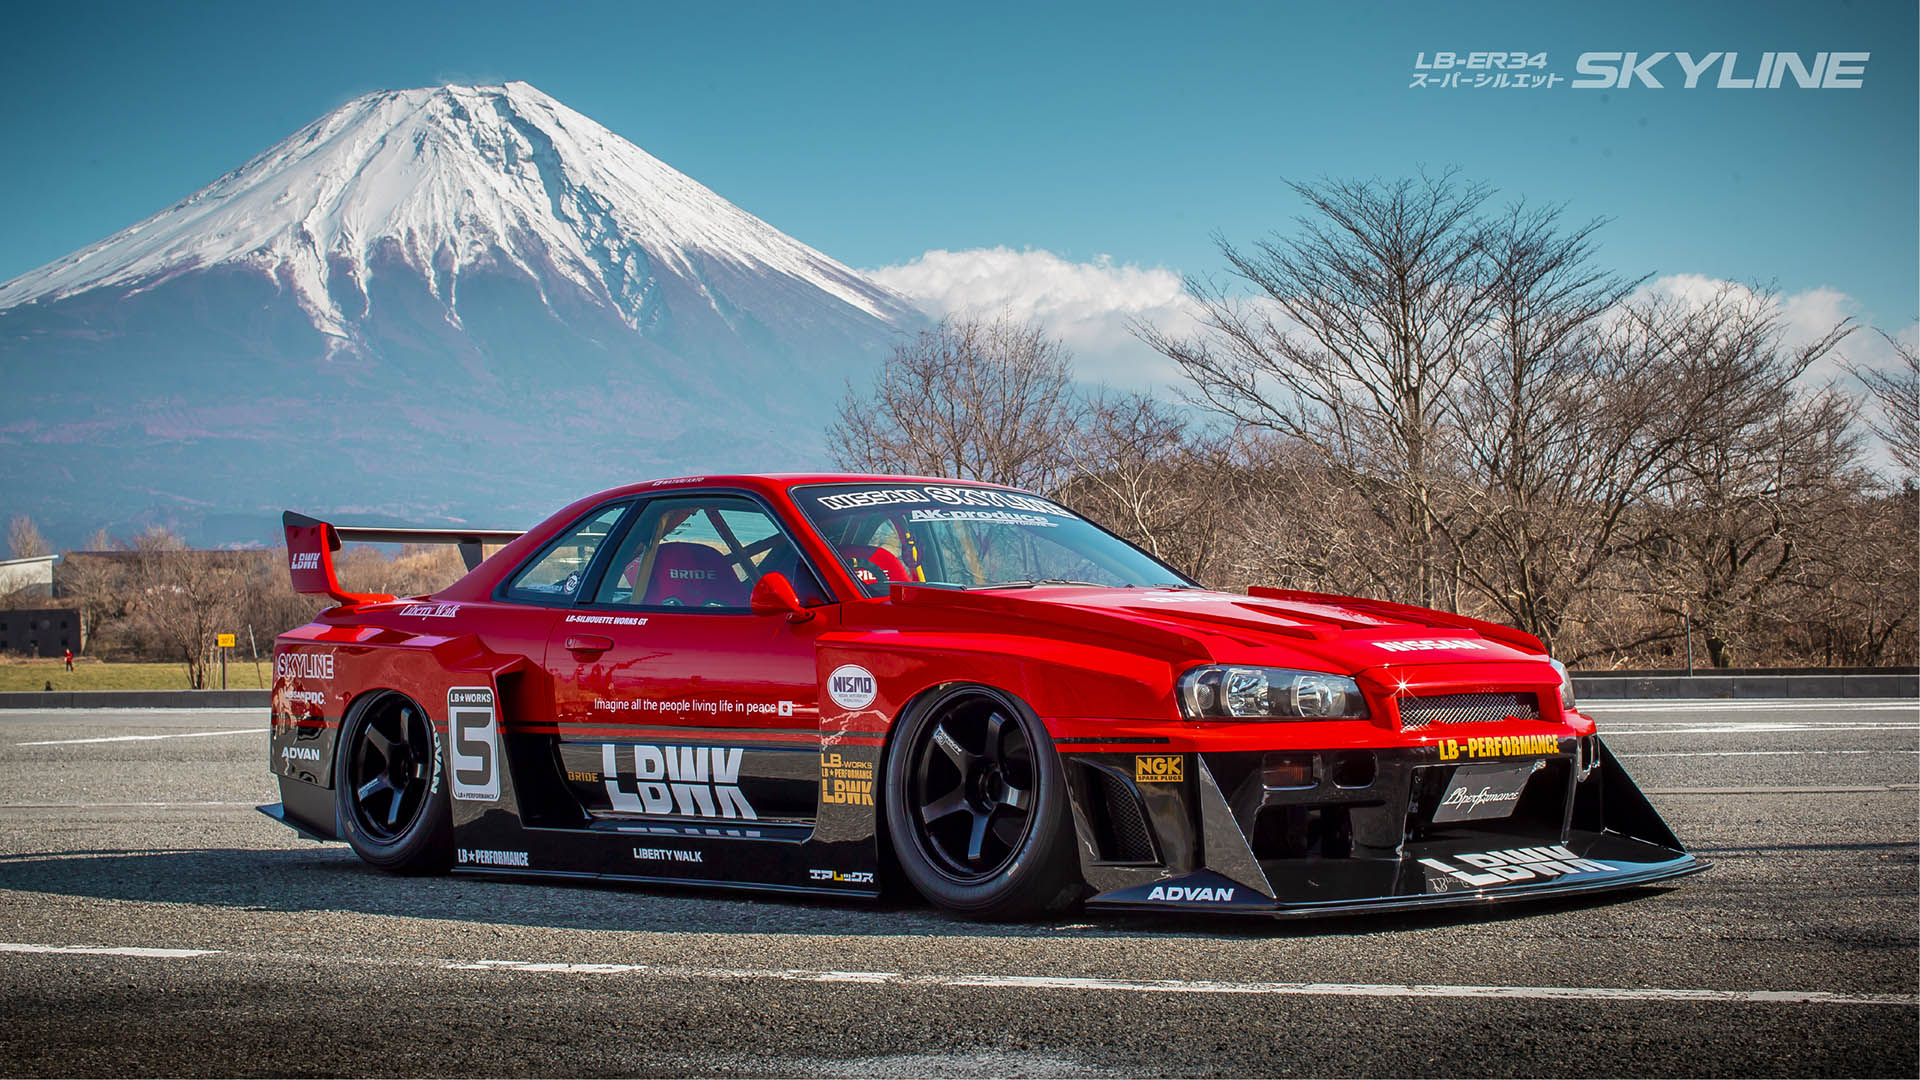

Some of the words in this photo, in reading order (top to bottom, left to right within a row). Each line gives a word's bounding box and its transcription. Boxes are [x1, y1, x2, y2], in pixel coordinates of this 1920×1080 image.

[818, 488, 931, 510] NISSAN
[923, 486, 1081, 520] SKYLINE
[291, 552, 321, 569] LBWK
[669, 568, 718, 580] BRIDE
[613, 617, 638, 625] WORKS
[638, 618, 649, 626] GT
[1372, 641, 1487, 652] NISSAN
[277, 653, 334, 679] SKYLINE
[833, 676, 872, 693] NISMO
[594, 698, 629, 713] Imagine
[631, 699, 641, 710] all
[643, 700, 658, 712] the
[659, 701, 691, 714] people
[692, 701, 717, 715] living
[719, 701, 734, 713] life
[735, 702, 744, 713] in
[746, 704, 776, 715] peace
[281, 747, 320, 761] ADVAN
[456, 711, 492, 785] 5
[1438, 734, 1560, 760] LB-PERFORMANCE
[1138, 757, 1181, 775] NGK
[568, 771, 599, 783] BRIDE
[602, 743, 758, 820] LBWK
[822, 779, 874, 806] LBWK
[633, 847, 672, 861] LIBERTY
[673, 850, 703, 863] WALK
[1147, 886, 1235, 901] ADVAN
